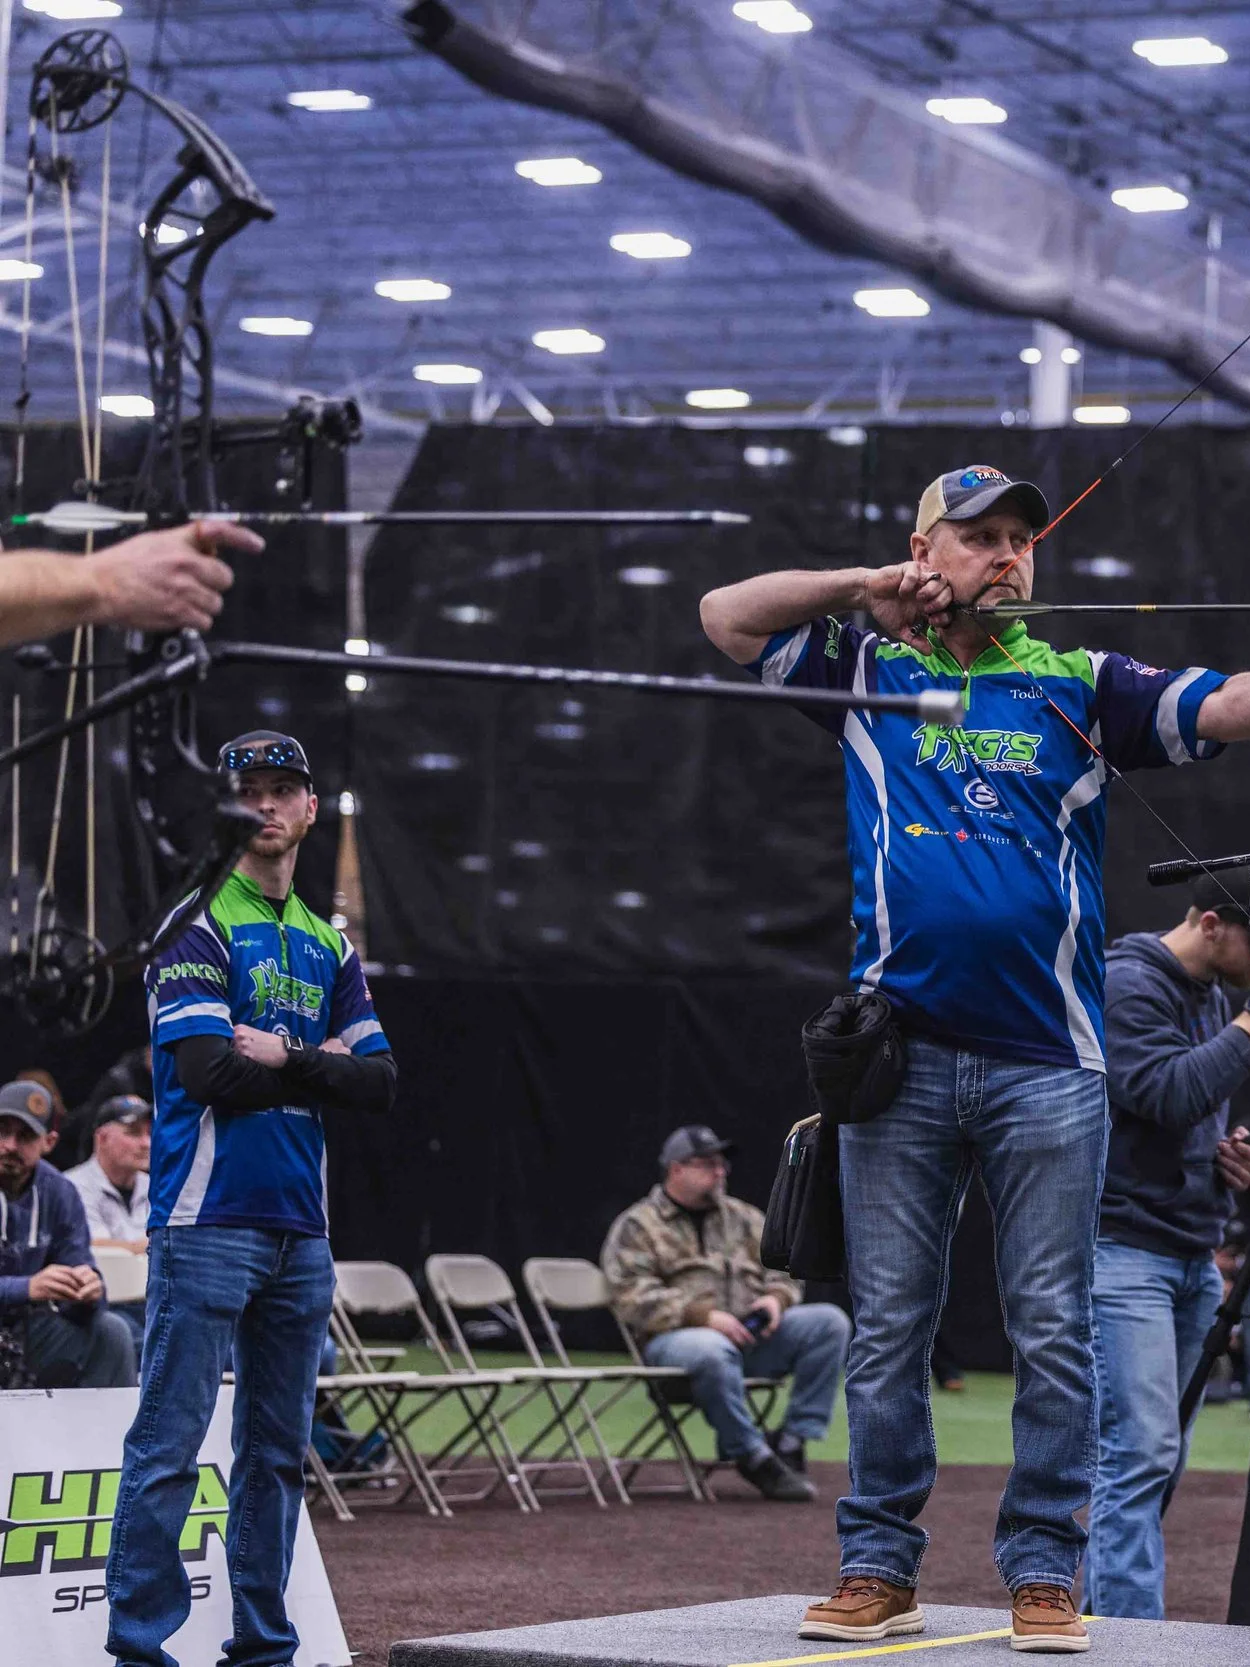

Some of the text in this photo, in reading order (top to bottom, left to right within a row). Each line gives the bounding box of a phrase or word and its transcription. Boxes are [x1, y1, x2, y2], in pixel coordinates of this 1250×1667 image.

[1010, 686, 1043, 700] Todd
[912, 722, 1042, 773] KG'S
[948, 805, 1015, 820] ELITE
[974, 833, 1010, 845] CONQUEST
[0, 1463, 229, 1577] HA
[52, 1575, 211, 1613] SPS
